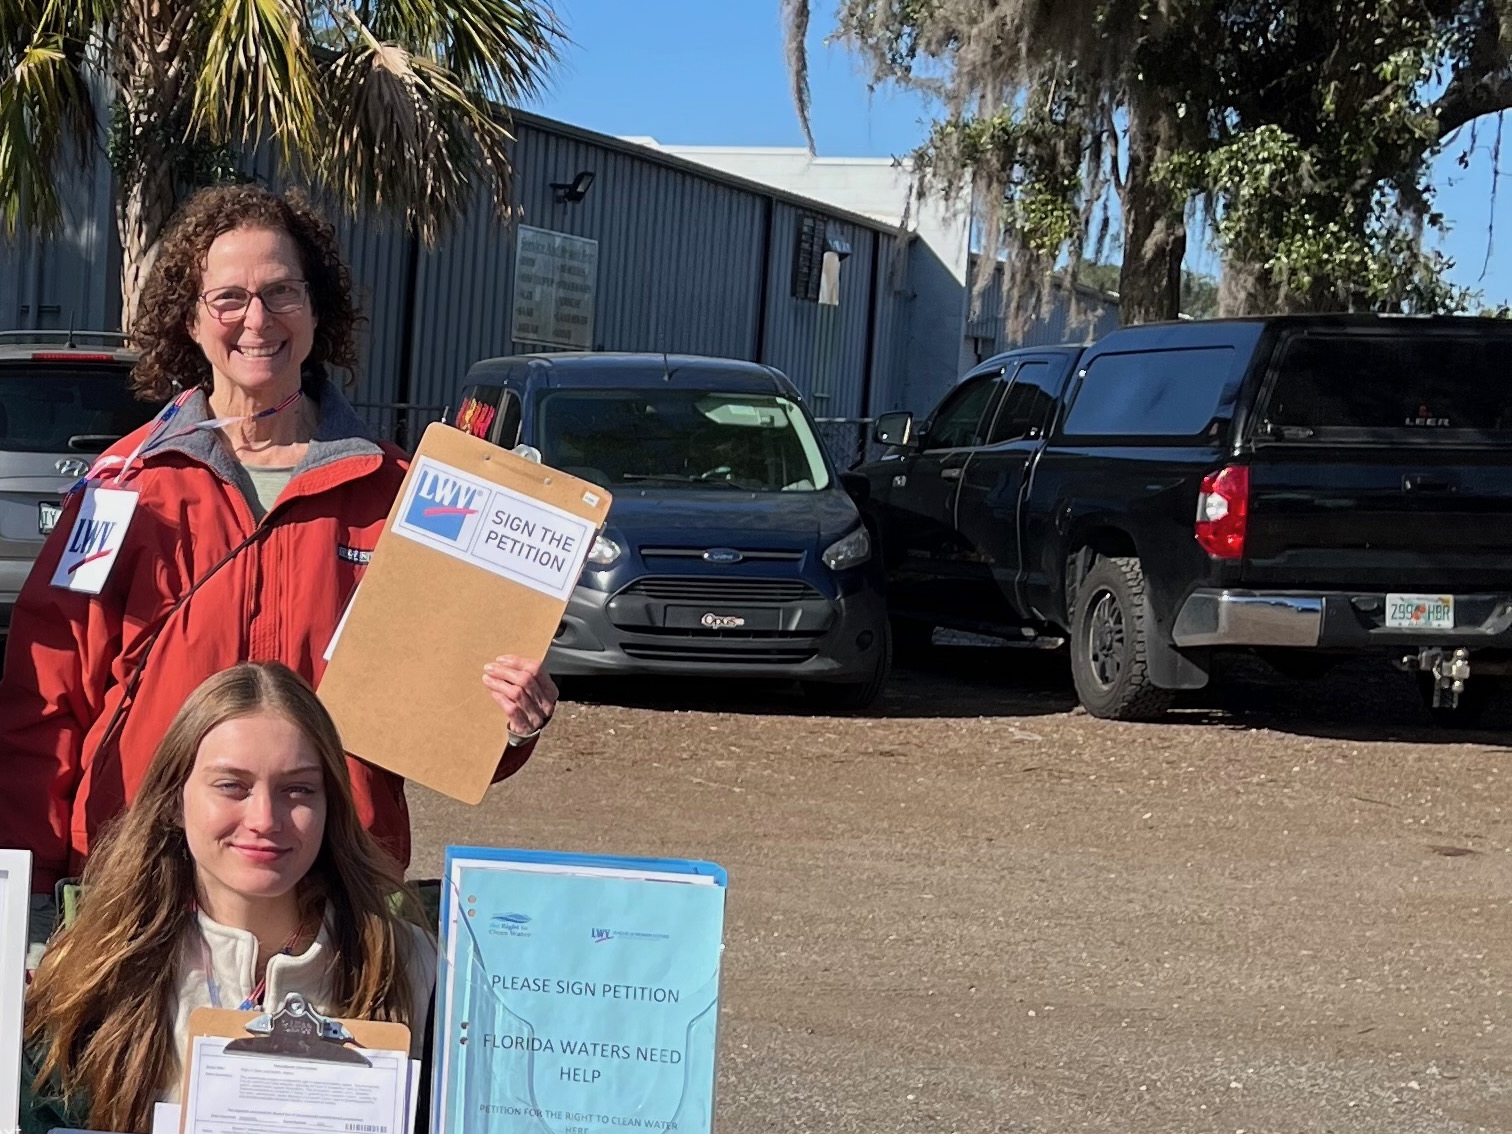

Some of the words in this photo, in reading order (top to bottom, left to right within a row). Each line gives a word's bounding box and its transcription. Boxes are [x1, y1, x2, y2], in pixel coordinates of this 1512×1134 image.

[1405, 417, 1450, 426] LEER
[69, 518, 117, 554] LWV
[491, 510, 537, 538] SIGN
[541, 526, 576, 553] THE
[484, 531, 567, 573] PETITION
[591, 927, 612, 939] LWV
[492, 974, 551, 993] PLEASE
[556, 979, 596, 997] SIGN
[602, 984, 680, 1004] PETITION
[483, 1033, 554, 1053] FLORIDA
[560, 1039, 631, 1060] WATERS
[637, 1046, 682, 1064] NEED
[560, 1066, 602, 1083] HELP
[479, 1104, 521, 1116] PETITION
[524, 1108, 543, 1118] FOR
[545, 1110, 563, 1120] THE
[565, 1112, 593, 1122] RIGHT
[596, 1115, 609, 1124] TO
[611, 1116, 642, 1127] CLEAN
[644, 1120, 678, 1130] WATER
